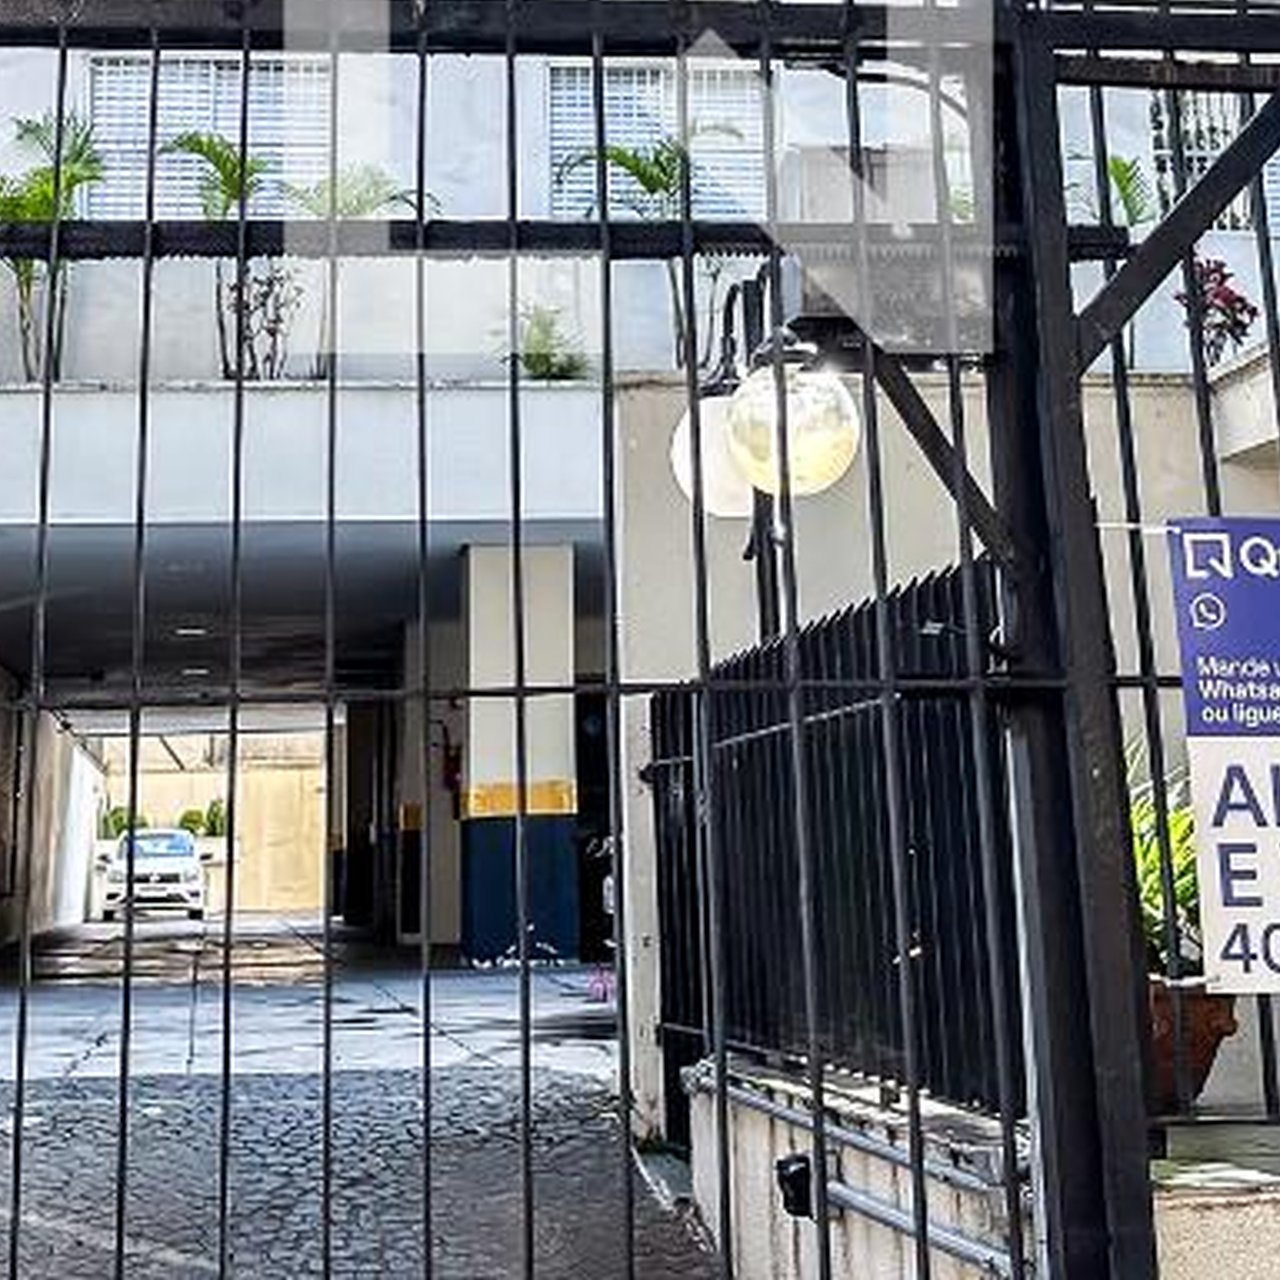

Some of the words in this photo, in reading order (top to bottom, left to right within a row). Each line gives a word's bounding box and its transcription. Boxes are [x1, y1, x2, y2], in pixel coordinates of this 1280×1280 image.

[1197, 656, 1271, 678] Mande
[1201, 706, 1229, 723] ou
[1216, 842, 1263, 908] E
